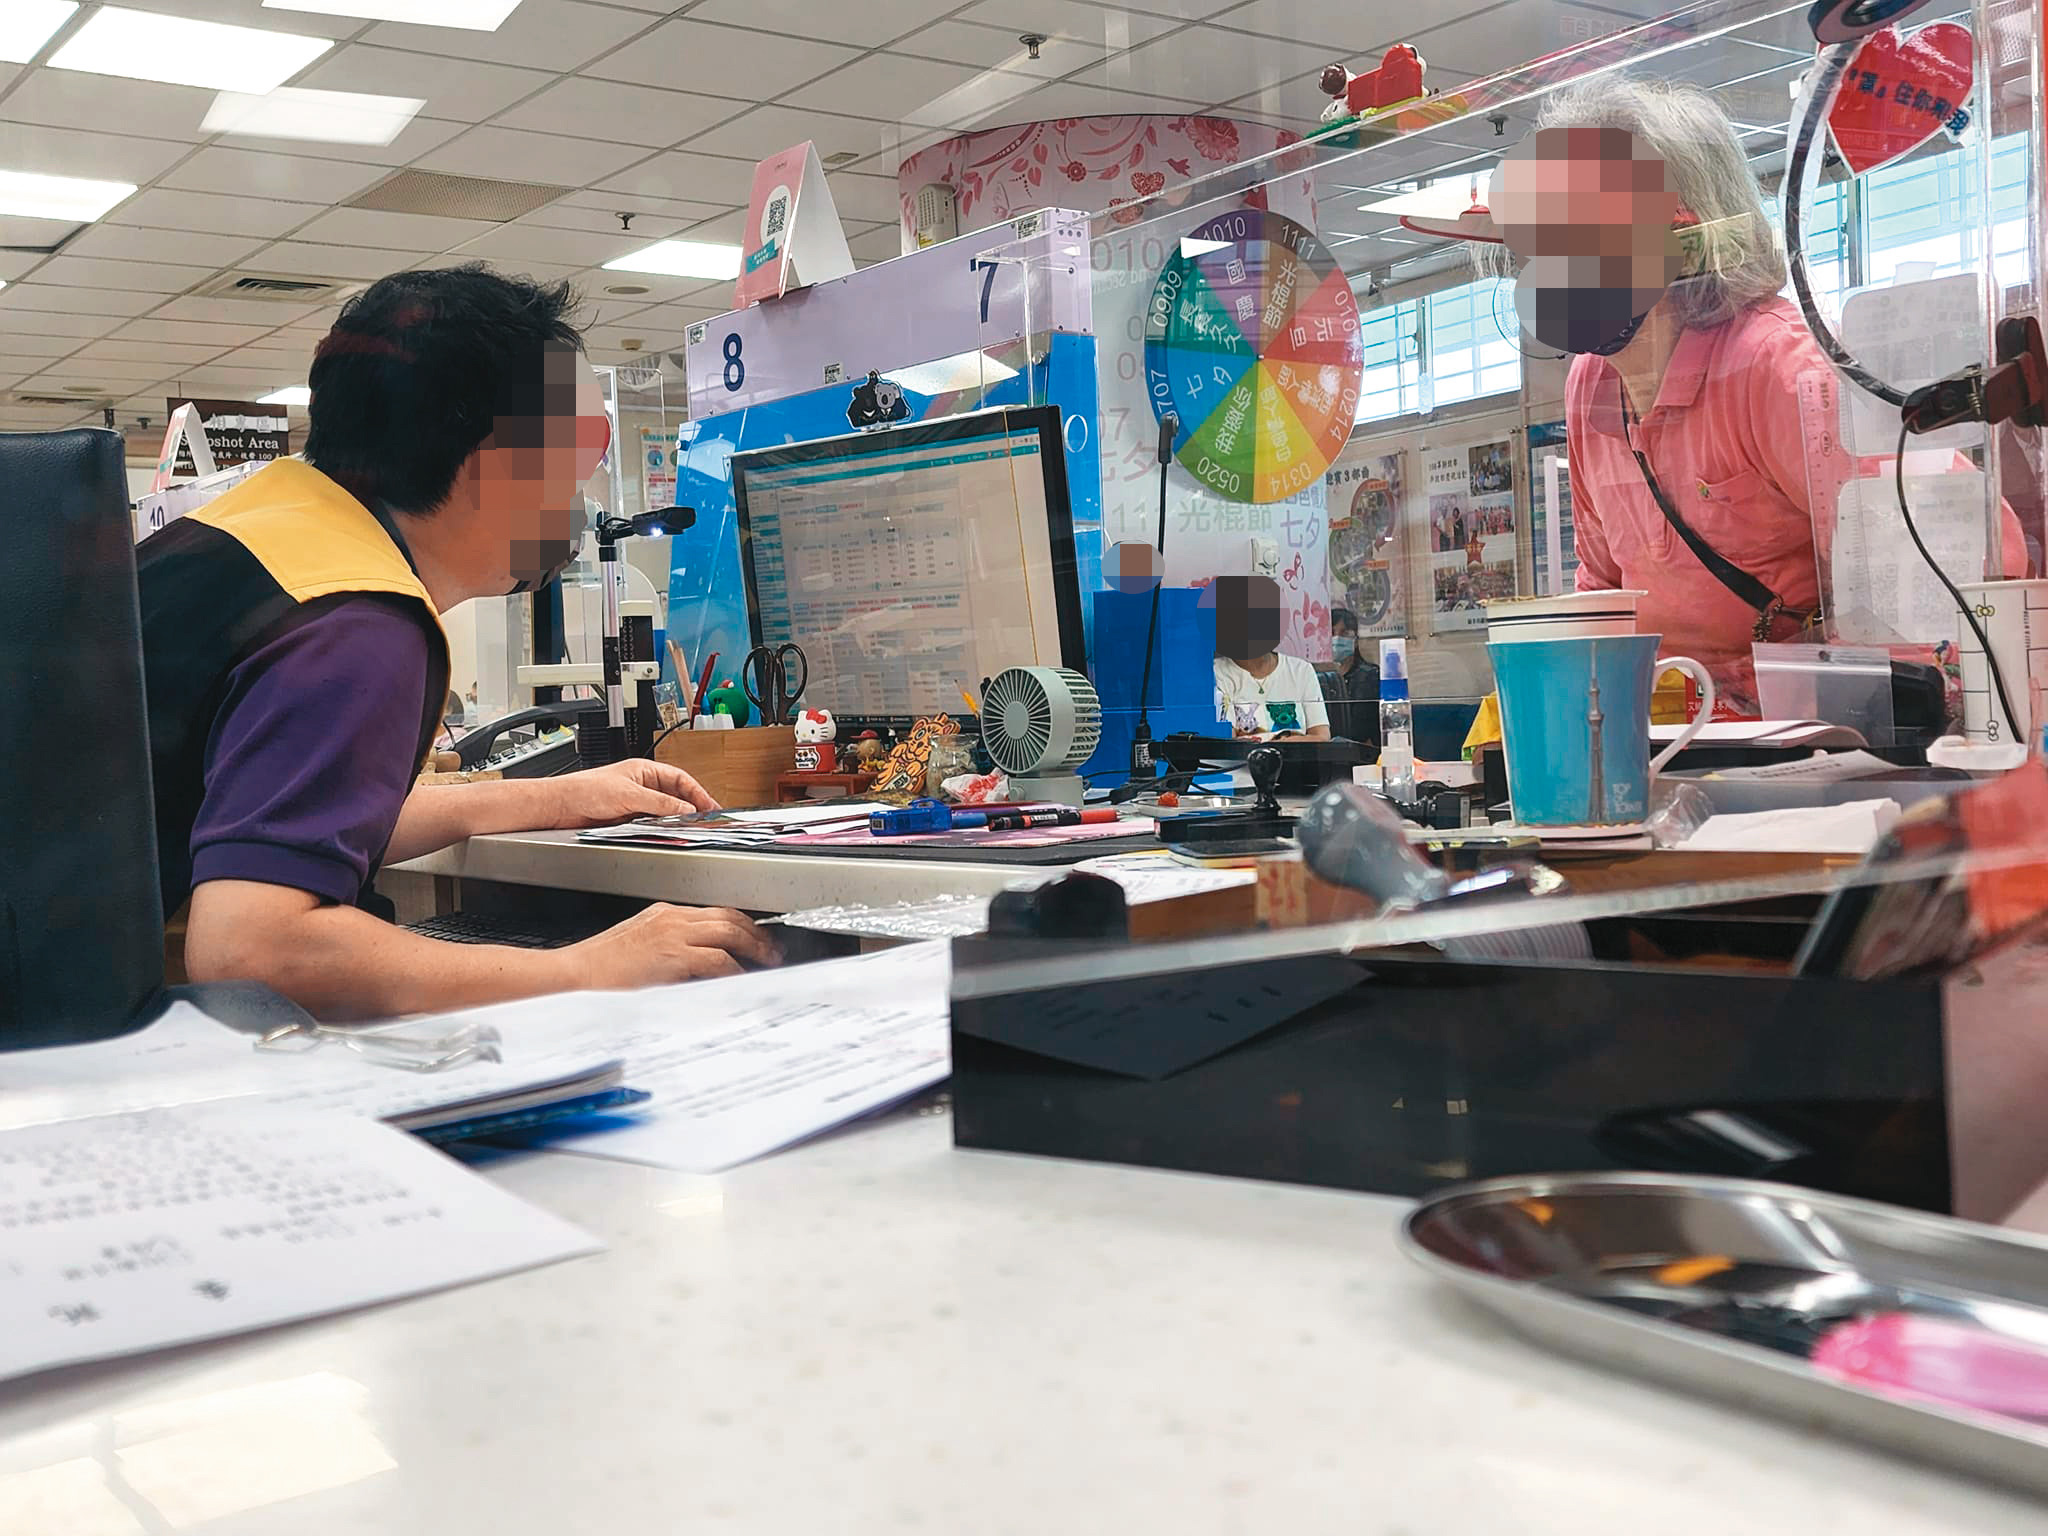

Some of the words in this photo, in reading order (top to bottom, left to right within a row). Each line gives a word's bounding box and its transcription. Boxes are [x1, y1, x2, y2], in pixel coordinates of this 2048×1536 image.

[1282, 224, 1316, 260] 1111
[970, 258, 1000, 323] 7
[1152, 270, 1182, 327] 0909
[1263, 259, 1298, 329] 光棍節
[722, 332, 745, 392] 8
[1187, 366, 1233, 400] 七夕
[1330, 388, 1357, 440] 0214
[248, 436, 279, 449] Area
[1197, 457, 1240, 493] 0520
[1270, 462, 1312, 496] 0314
[1178, 498, 1272, 532] 光棍節
[1279, 508, 1321, 549] 七夕
